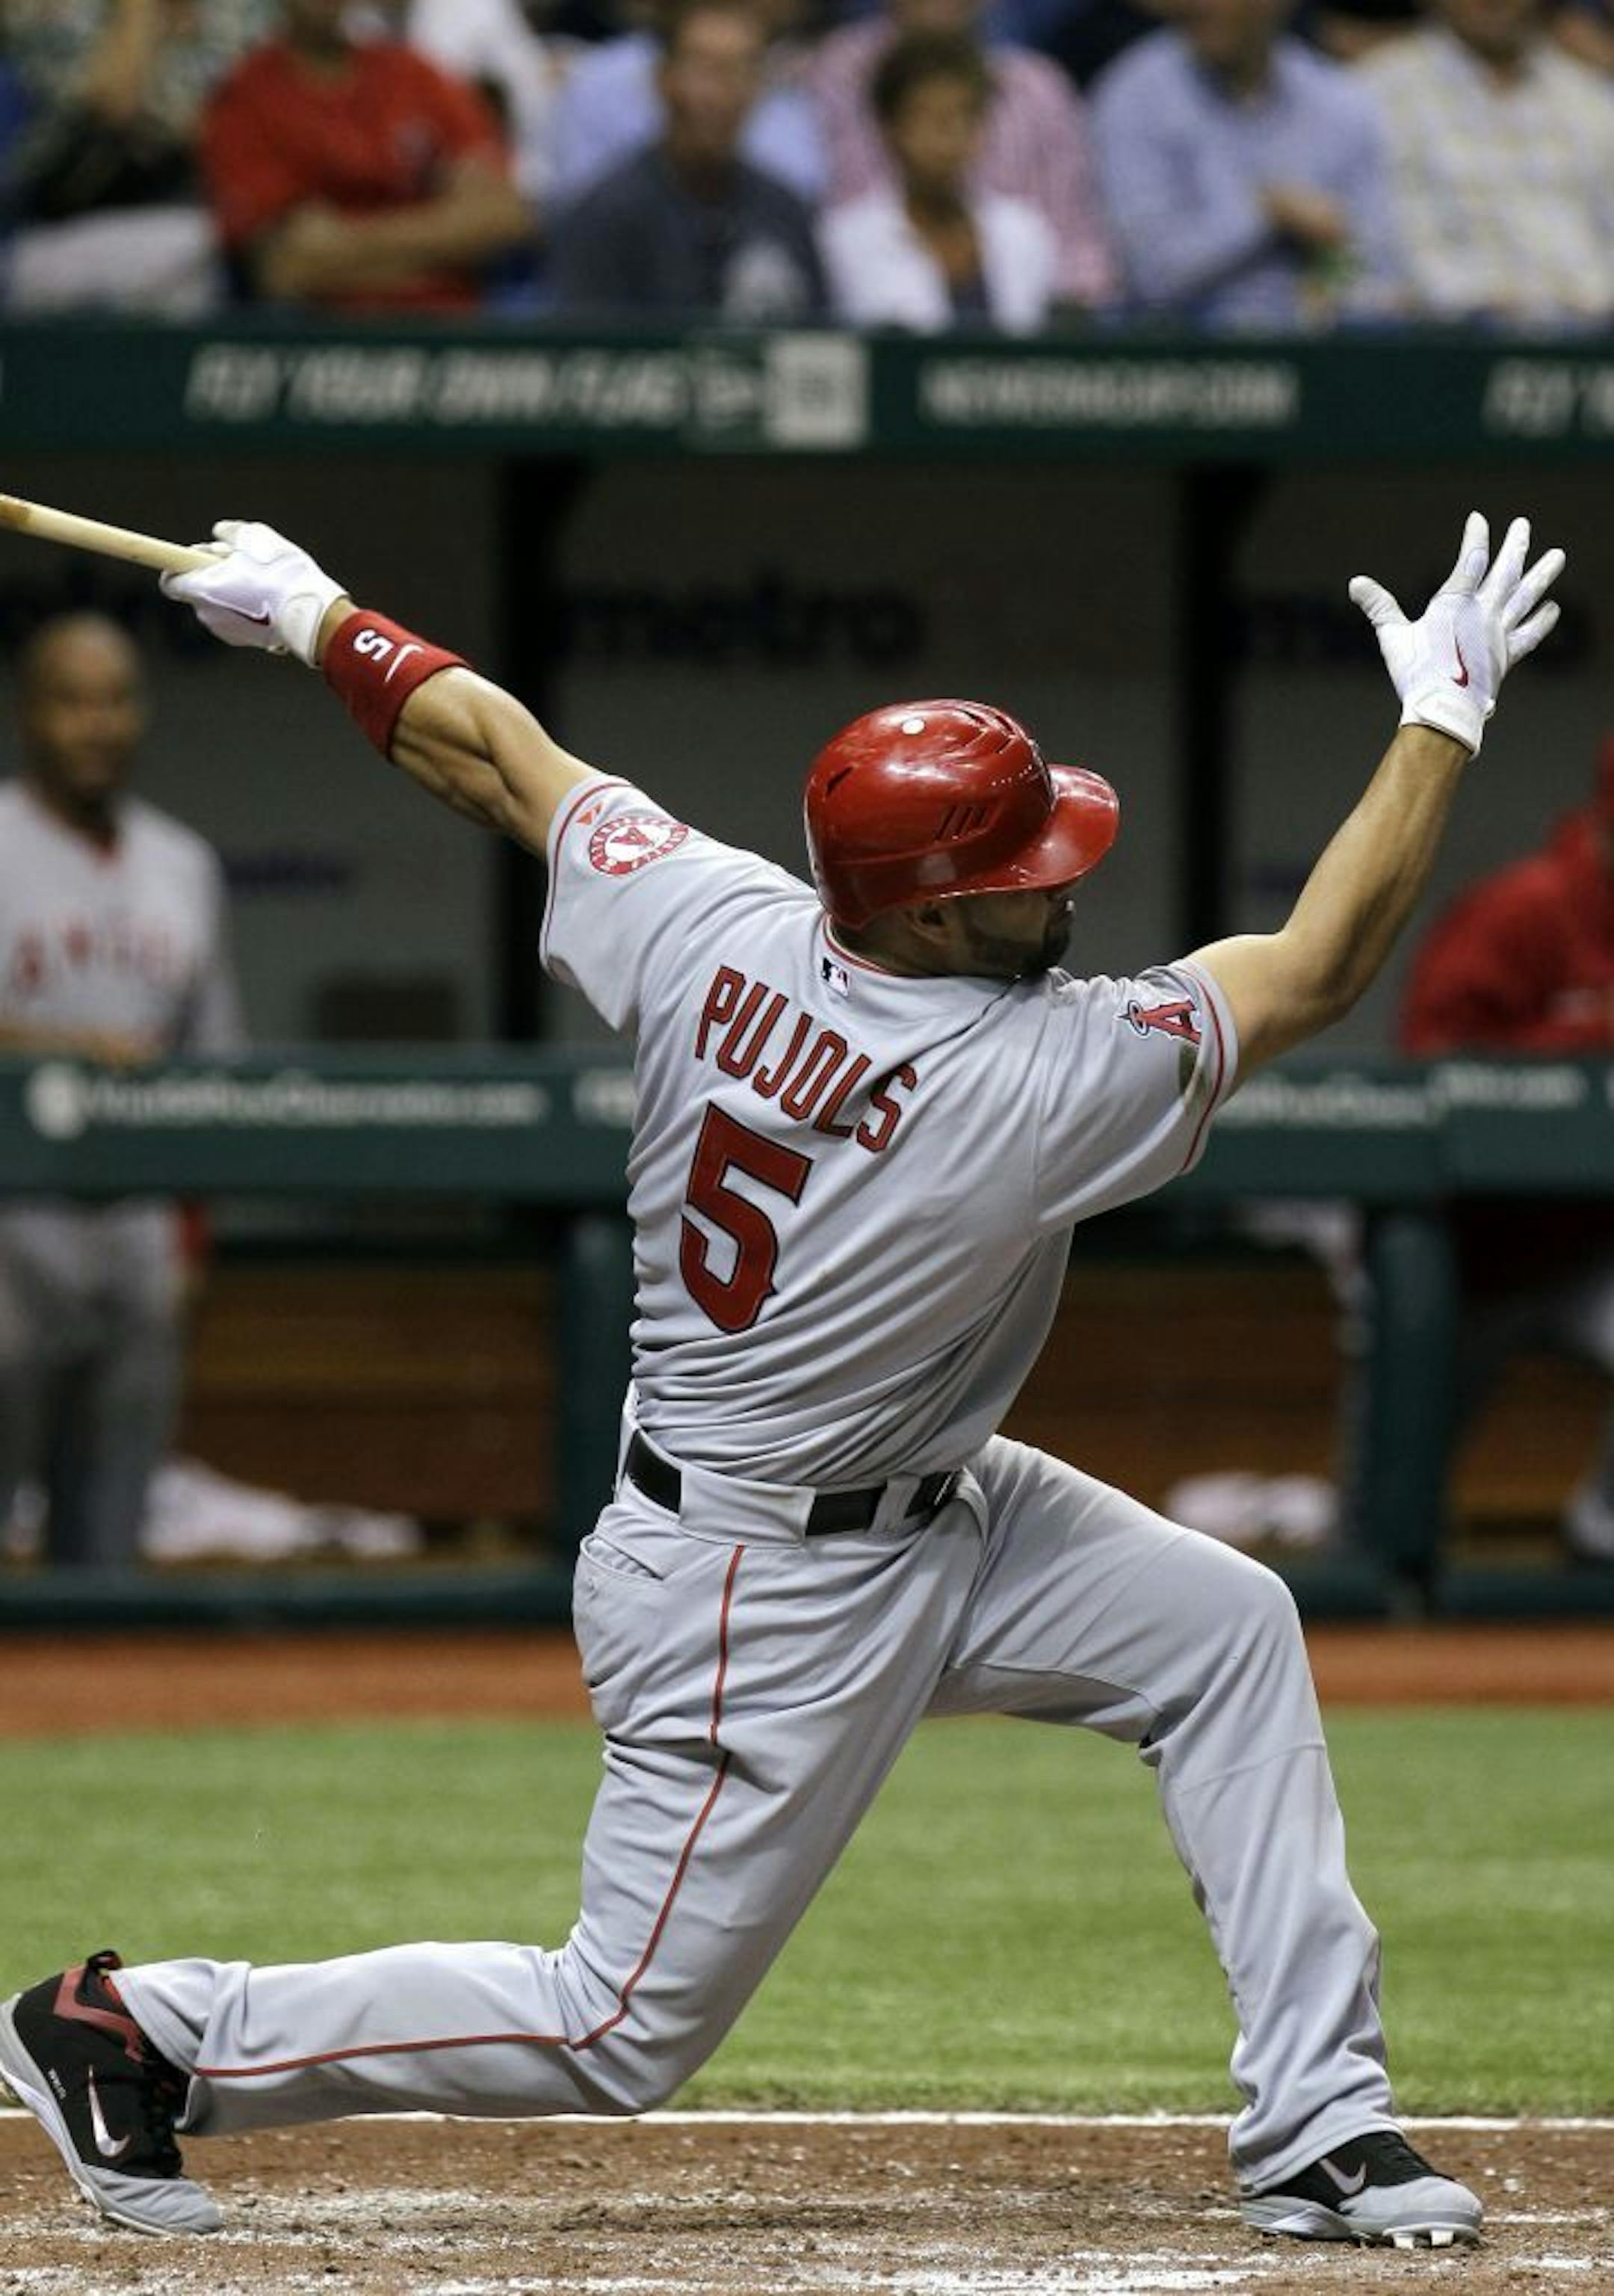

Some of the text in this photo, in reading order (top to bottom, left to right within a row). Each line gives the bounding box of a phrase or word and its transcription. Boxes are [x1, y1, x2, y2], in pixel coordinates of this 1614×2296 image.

[353, 629, 394, 660] 5
[695, 964, 918, 1152] PUJOLS
[1119, 999, 1202, 1045] A
[680, 1100, 814, 1333] 5
